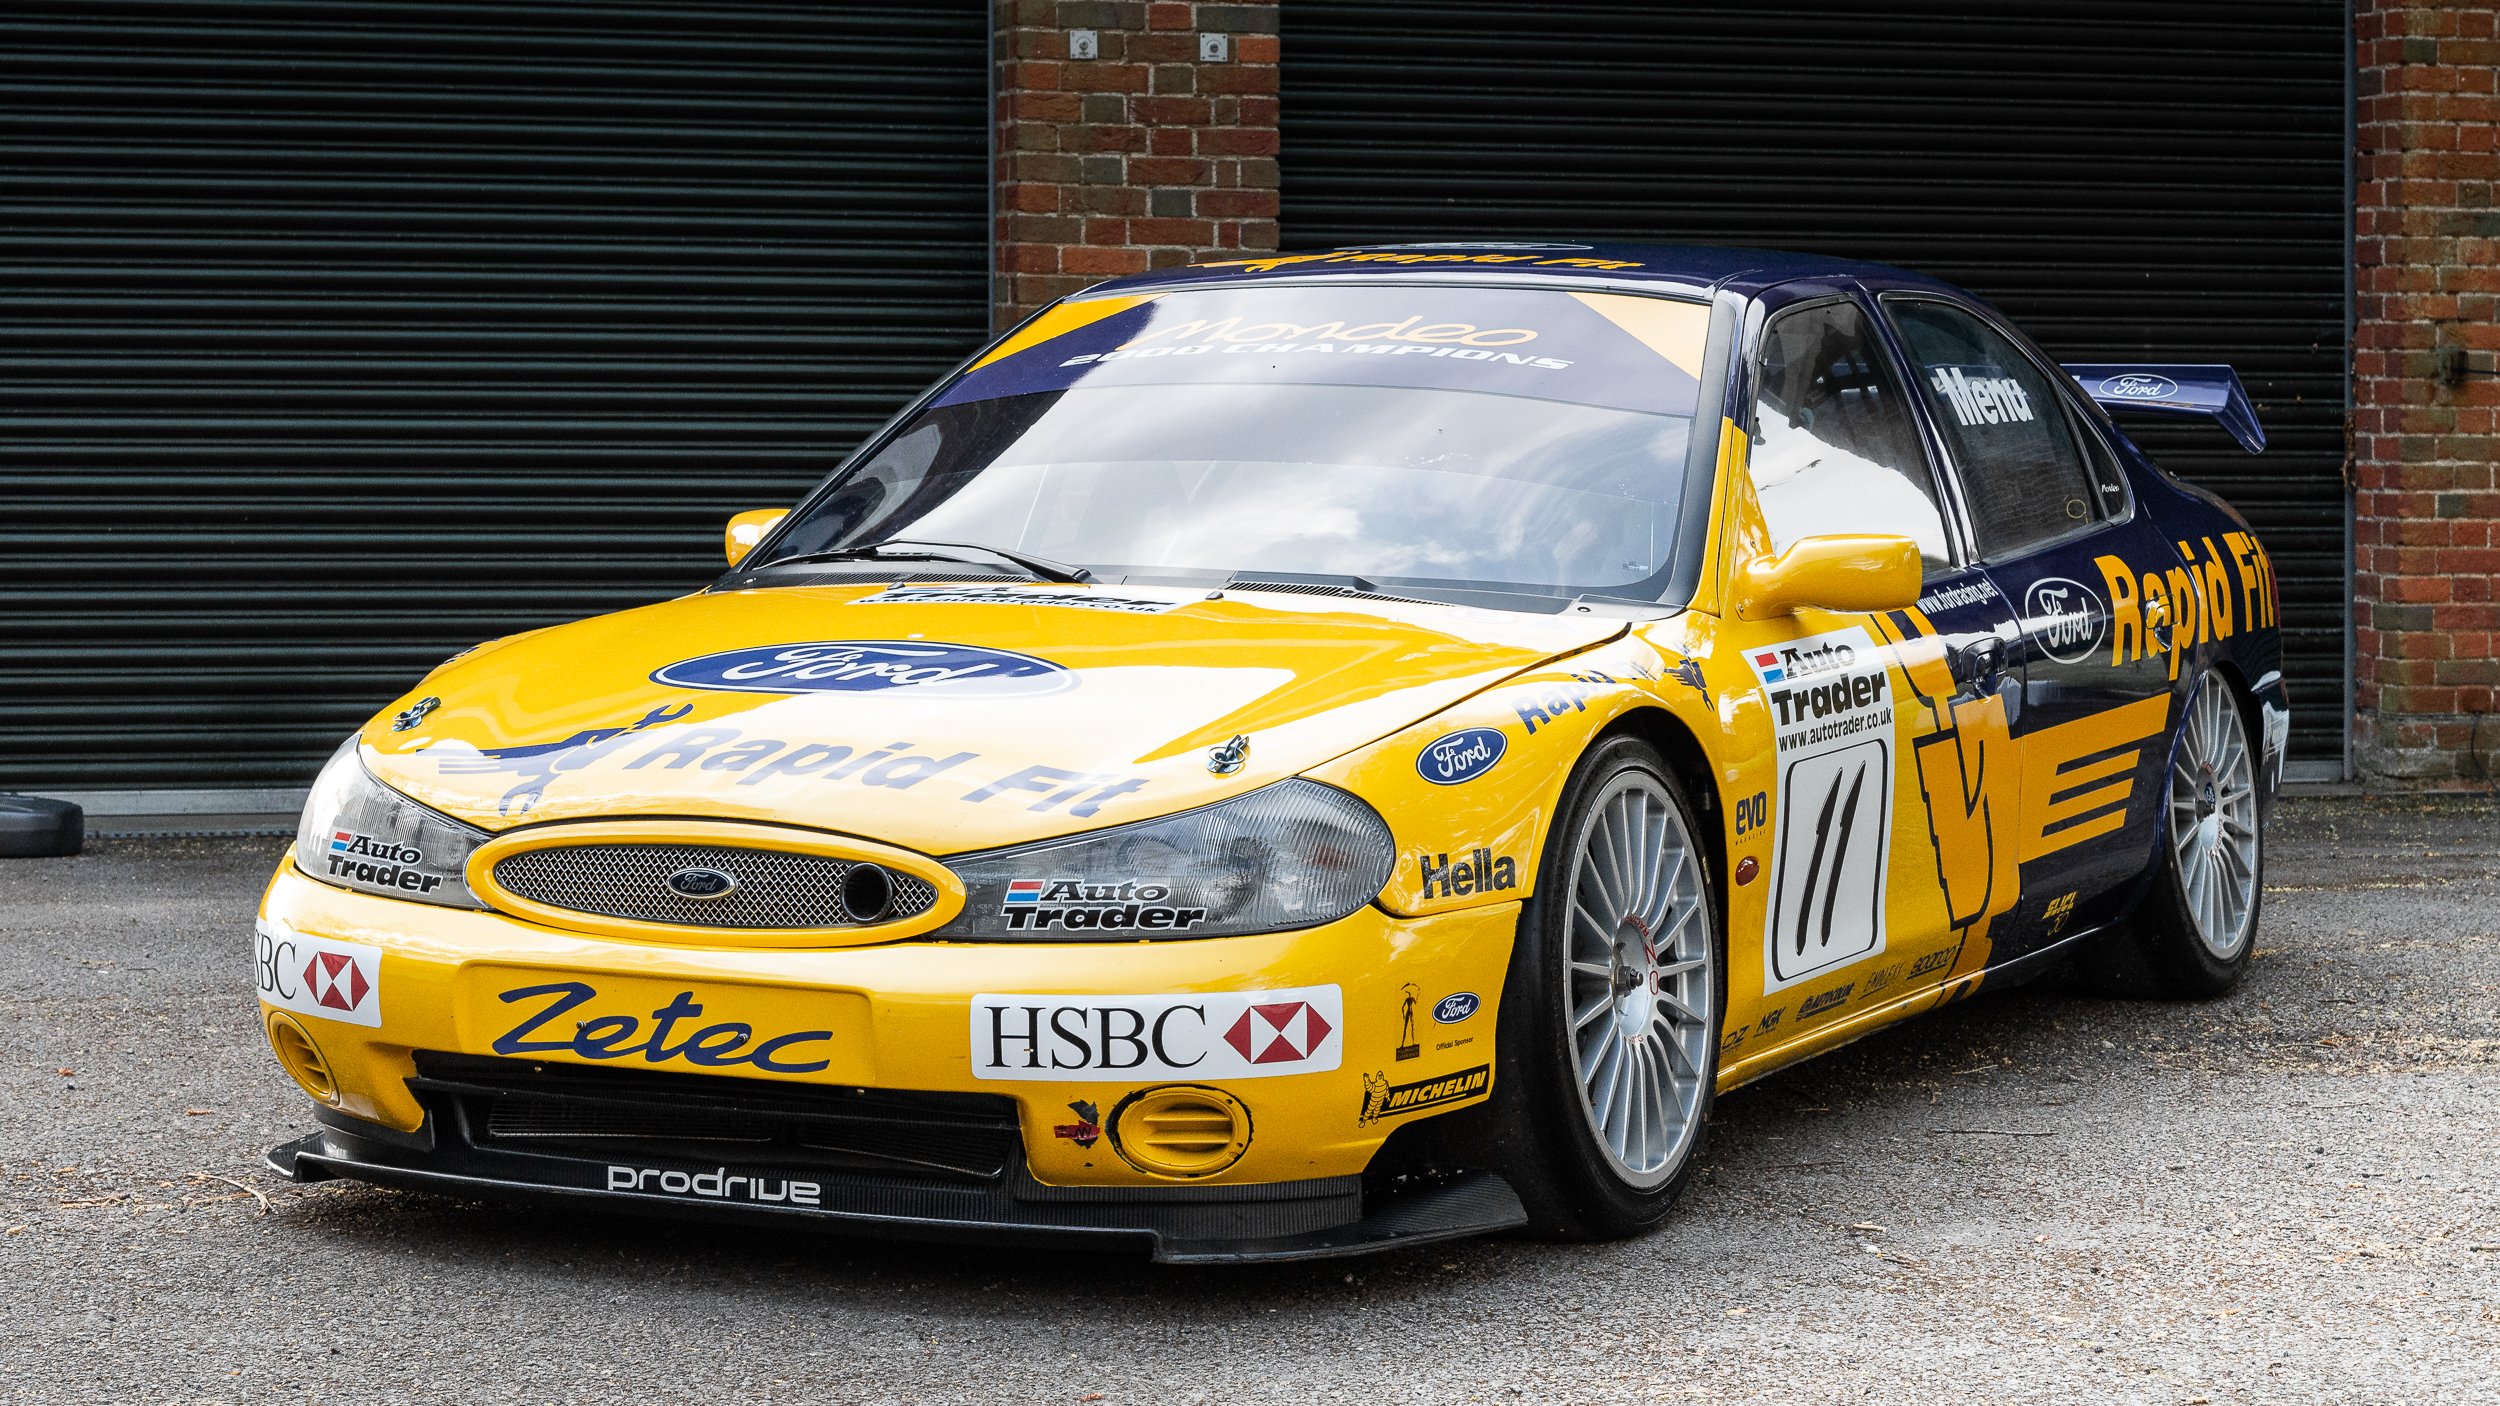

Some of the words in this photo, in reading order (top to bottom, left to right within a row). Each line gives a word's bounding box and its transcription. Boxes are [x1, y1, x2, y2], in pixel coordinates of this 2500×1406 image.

[1115, 315, 1539, 351] Mondeo
[1058, 343, 1215, 368] 2000
[1232, 343, 1575, 371] CHAMPIONS
[1936, 366, 2034, 426] Menu
[2113, 376, 2161, 397] Ford
[2038, 587, 2094, 648] Ford
[2094, 537, 2233, 681] Rapid
[2226, 531, 2275, 633] Fit
[721, 646, 1000, 687] Ford
[1780, 641, 1856, 680] Auto
[1770, 671, 1887, 726] Trader
[1778, 706, 1893, 753] www.autotrader.co.uk
[622, 727, 981, 789] Rapid
[966, 764, 1151, 820] Fit
[1432, 735, 1492, 778] Ford
[1735, 791, 1767, 836] evo
[346, 834, 422, 864] Auto
[1795, 759, 1867, 957] 11
[327, 853, 442, 893] Trader
[680, 872, 718, 891] Ford
[1040, 879, 1170, 902] Auto
[1420, 847, 1516, 900] Hella
[1002, 903, 1206, 930] Trader
[254, 928, 297, 1001] BC
[491, 981, 834, 1074] Zetec
[1441, 996, 1472, 1019] Ford
[983, 1003, 1209, 1070] HSBC
[1388, 1070, 1487, 1108] MICHELIN
[607, 1165, 821, 1205] prodrive
